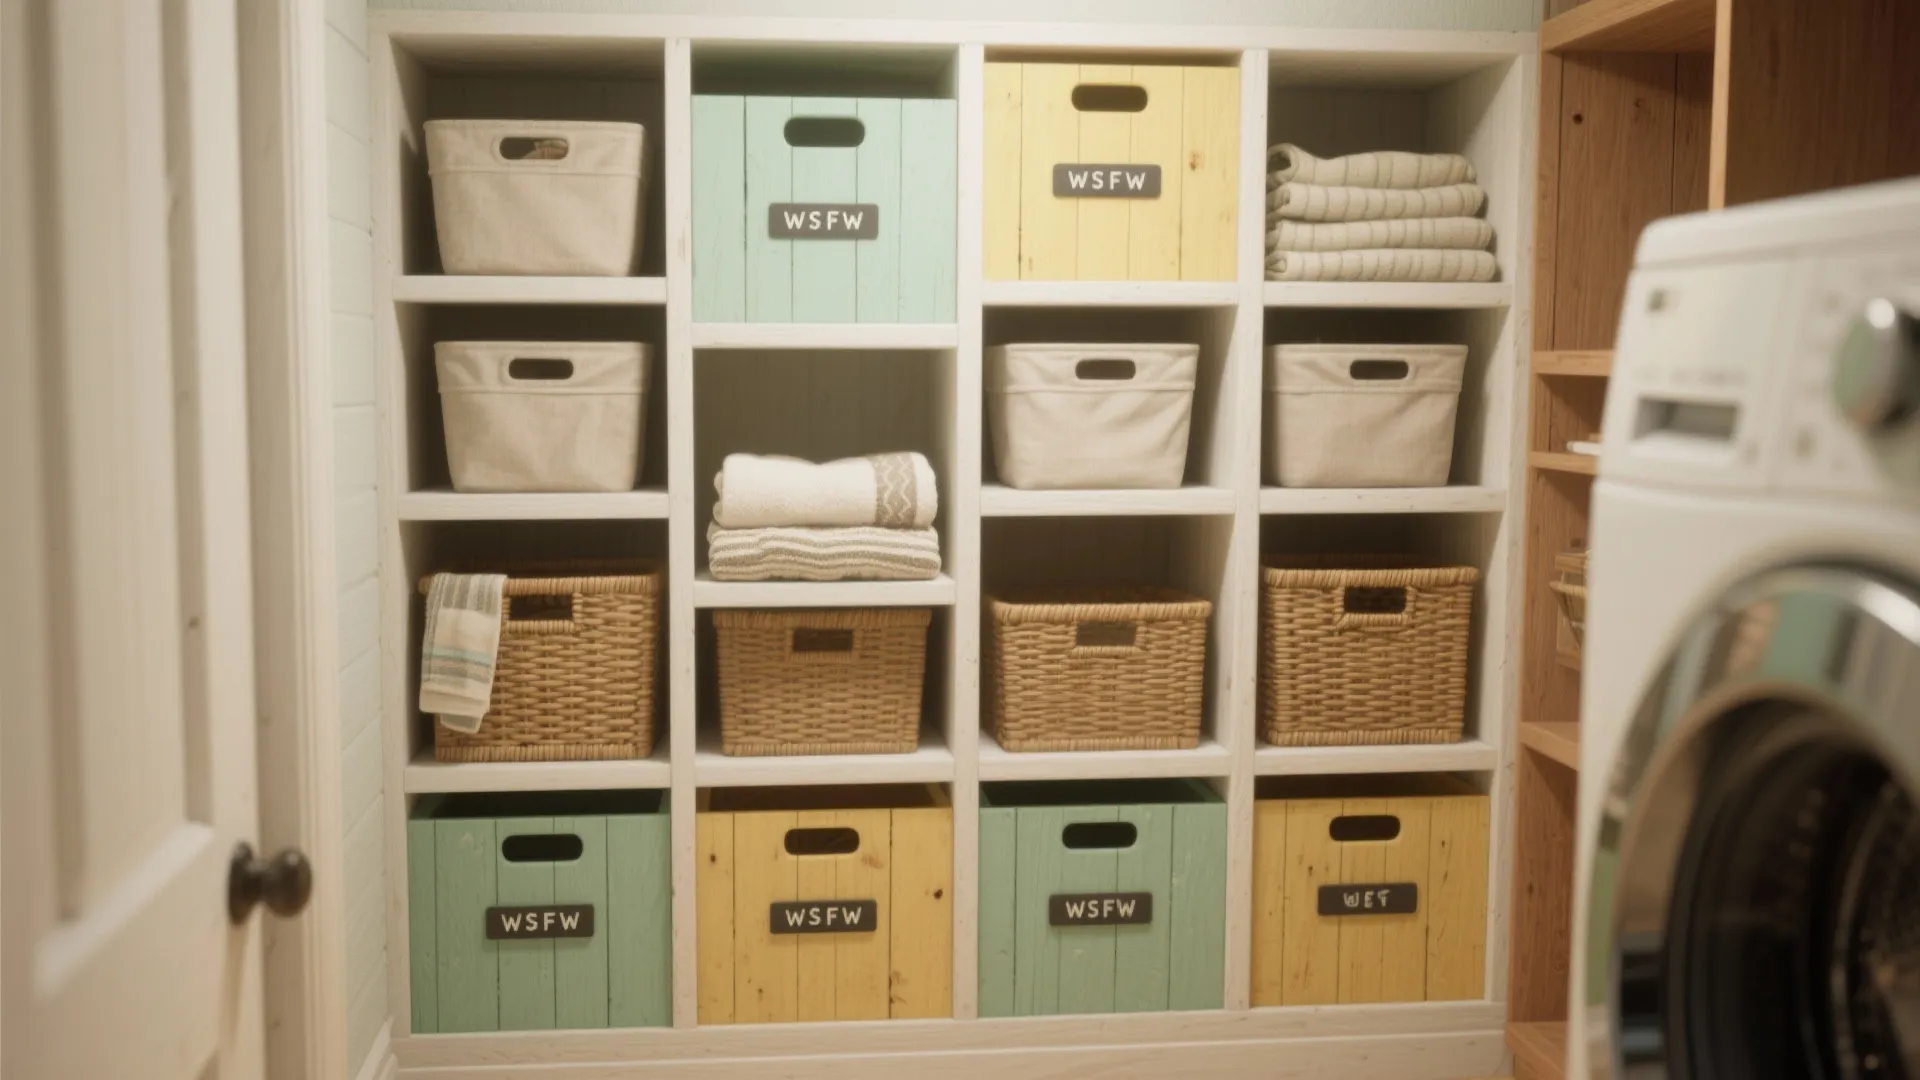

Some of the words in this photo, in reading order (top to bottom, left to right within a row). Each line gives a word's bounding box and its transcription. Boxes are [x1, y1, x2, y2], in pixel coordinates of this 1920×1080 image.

[1068, 169, 1147, 191] WSFW
[783, 209, 864, 232] WSFW
[785, 905, 863, 928] WSFW
[1064, 898, 1137, 920] WSFW
[501, 911, 581, 933] WSFW
